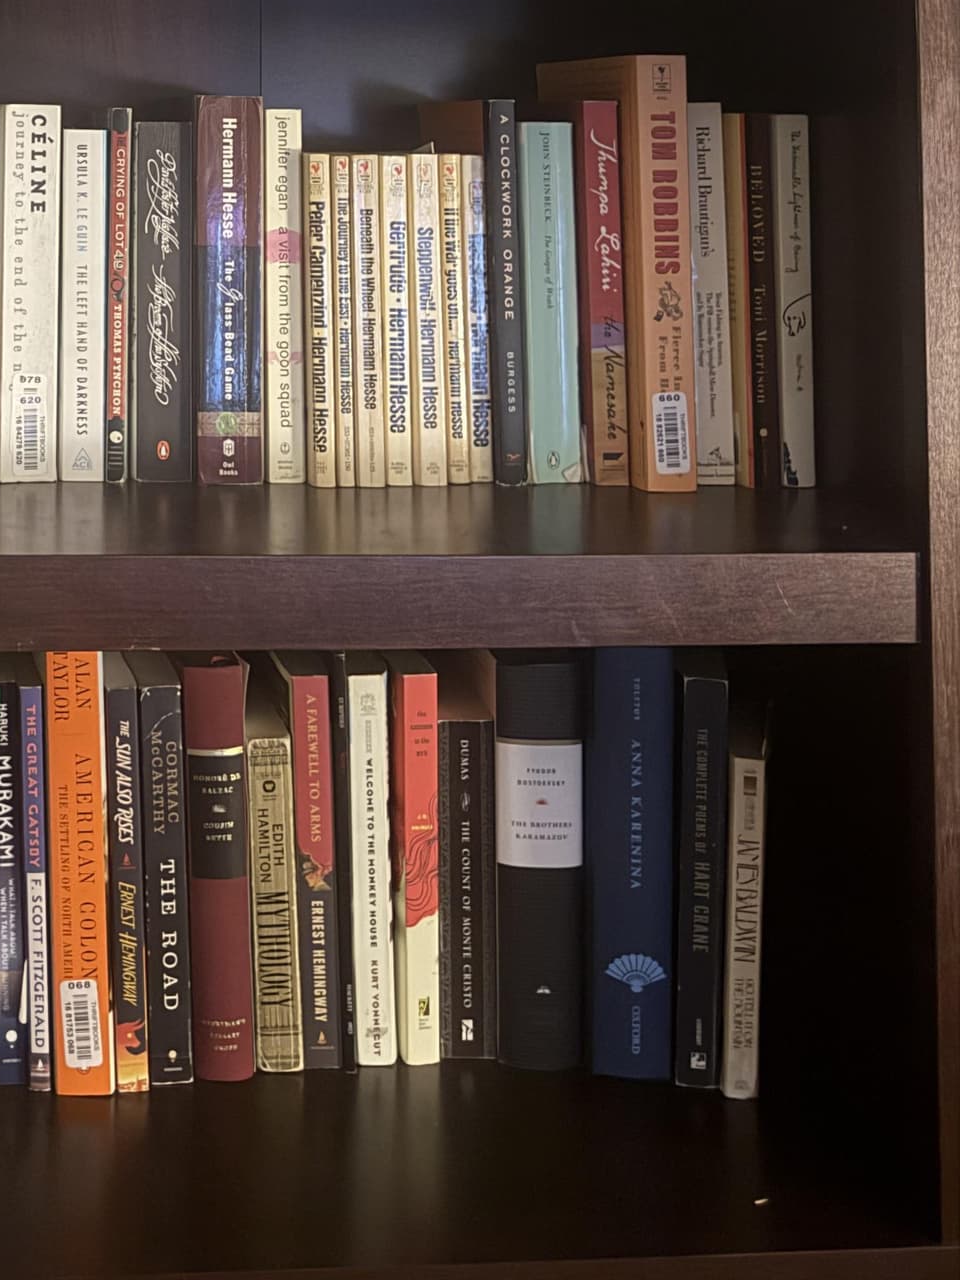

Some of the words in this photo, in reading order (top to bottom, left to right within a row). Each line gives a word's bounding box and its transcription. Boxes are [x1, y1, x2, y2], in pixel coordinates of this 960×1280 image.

[275, 116, 290, 170] jennifer
[500, 115, 508, 124] A
[650, 111, 678, 161] TOM
[30, 114, 54, 213] CÉLINE
[222, 118, 238, 188] Hermann
[539, 132, 550, 159] JOHN
[275, 176, 288, 211] egan
[500, 134, 512, 238] CLOCKWORK
[543, 164, 552, 222] STEINBECK
[222, 192, 238, 238] Hesse
[309, 201, 326, 242] Peter
[652, 170, 680, 274] ROBBINS
[389, 221, 407, 293] Gertrude
[310, 246, 328, 328] Camenzind
[503, 249, 514, 320] ORANGE
[113, 304, 122, 354] THOMAS
[339, 328, 351, 377] Hermann
[362, 318, 377, 370] Hermann
[389, 309, 407, 381] Hermann
[420, 319, 437, 382] Hermann
[113, 357, 122, 415] PYNCHON
[312, 337, 328, 404] Hermann
[364, 374, 377, 410] Hesse
[506, 352, 516, 413] BURGESS
[340, 381, 352, 414] Hesse
[390, 385, 408, 433] Hesse
[422, 386, 438, 429] Hesse
[313, 408, 329, 453] Hesse
[53, 652, 71, 721] TAYLOR
[75, 658, 92, 709] ALAN
[0, 703, 9, 746] HARUKI
[166, 741, 179, 823] CORMAC
[460, 740, 470, 780] DUMAS
[75, 754, 95, 884] AMERICAN
[460, 821, 470, 842] THE
[515, 833, 568, 841] KARAMAZOV
[258, 808, 272, 883] HAMILTON
[272, 823, 285, 866] EDITH
[160, 859, 176, 915] THE
[461, 849, 471, 891] COUNT
[118, 881, 137, 929] ERNEST
[311, 900, 325, 945] ERNEST
[462, 896, 470, 910] OF
[256, 892, 294, 1008] MYTHOLOGY
[462, 917, 472, 957] MONTE
[119, 932, 138, 1007] HEMINGWAY
[161, 931, 179, 1010] ROAD
[313, 950, 328, 1022] HEMINGWAY
[370, 960, 379, 990] KURT
[463, 964, 472, 1008] CRISTO
[632, 1006, 640, 1054] OXFORD
